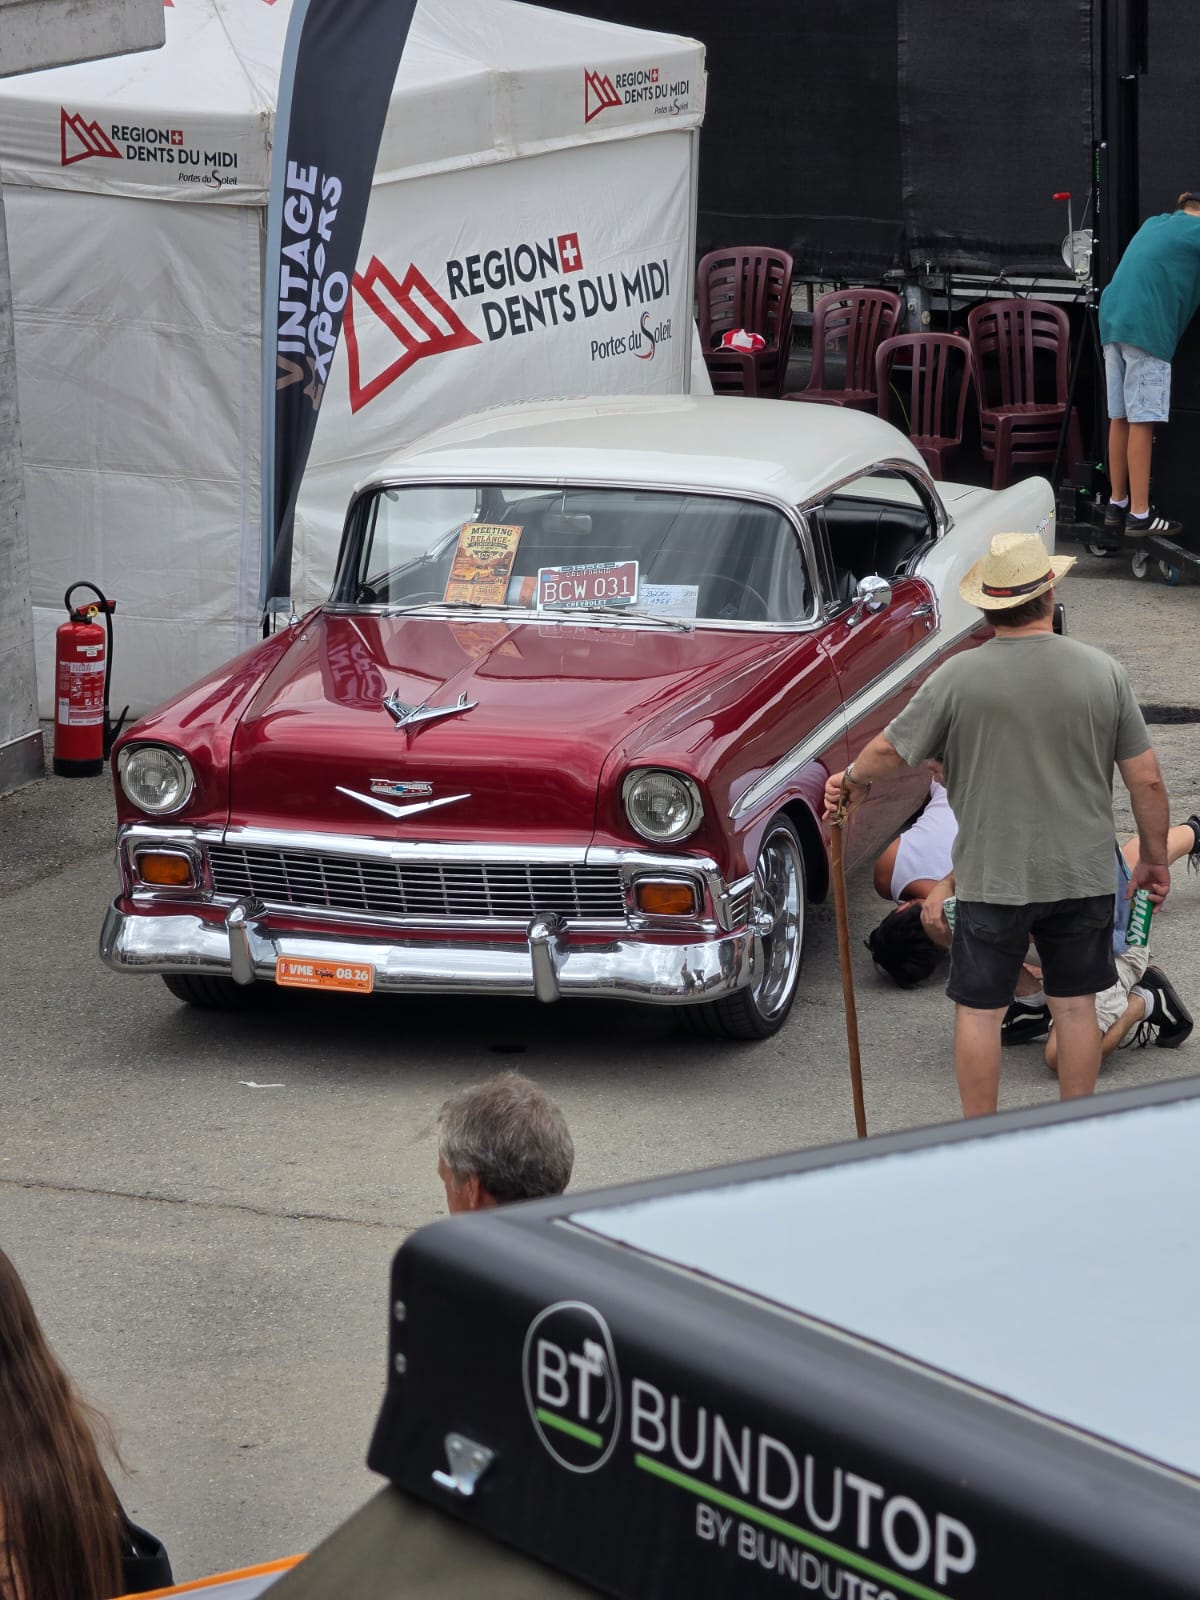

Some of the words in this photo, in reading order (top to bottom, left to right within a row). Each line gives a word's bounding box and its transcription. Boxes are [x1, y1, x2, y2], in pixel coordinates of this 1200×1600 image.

[615, 69, 651, 89] REGION
[624, 86, 653, 105] DENTS
[655, 84, 668, 99] DU
[669, 80, 689, 97] MIDI
[111, 124, 170, 145] REGION
[126, 145, 175, 164] DENTS
[178, 149, 200, 166] DU
[203, 152, 238, 168] MIDI
[178, 172, 201, 183] Portes
[201, 173, 212, 184] du
[209, 169, 238, 189] Soleil
[275, 160, 318, 390] VINTAGE
[446, 237, 560, 300] REGION
[481, 283, 577, 342] DENTS
[577, 273, 618, 319] DU
[621, 258, 670, 308] MIDI
[590, 335, 626, 361] Portes
[628, 330, 642, 352] du
[637, 310, 672, 361] Soleil
[471, 527, 513, 537] MEETING
[543, 580, 587, 603] BCW
[594, 575, 631, 597] 031
[566, 600, 607, 608] CHEVROLET
[1126, 889, 1150, 946] Sprite
[289, 963, 314, 976] VME
[536, 1338, 604, 1420] BT
[630, 1378, 978, 1586] BUNDUTOP
[695, 1502, 733, 1548] BY
